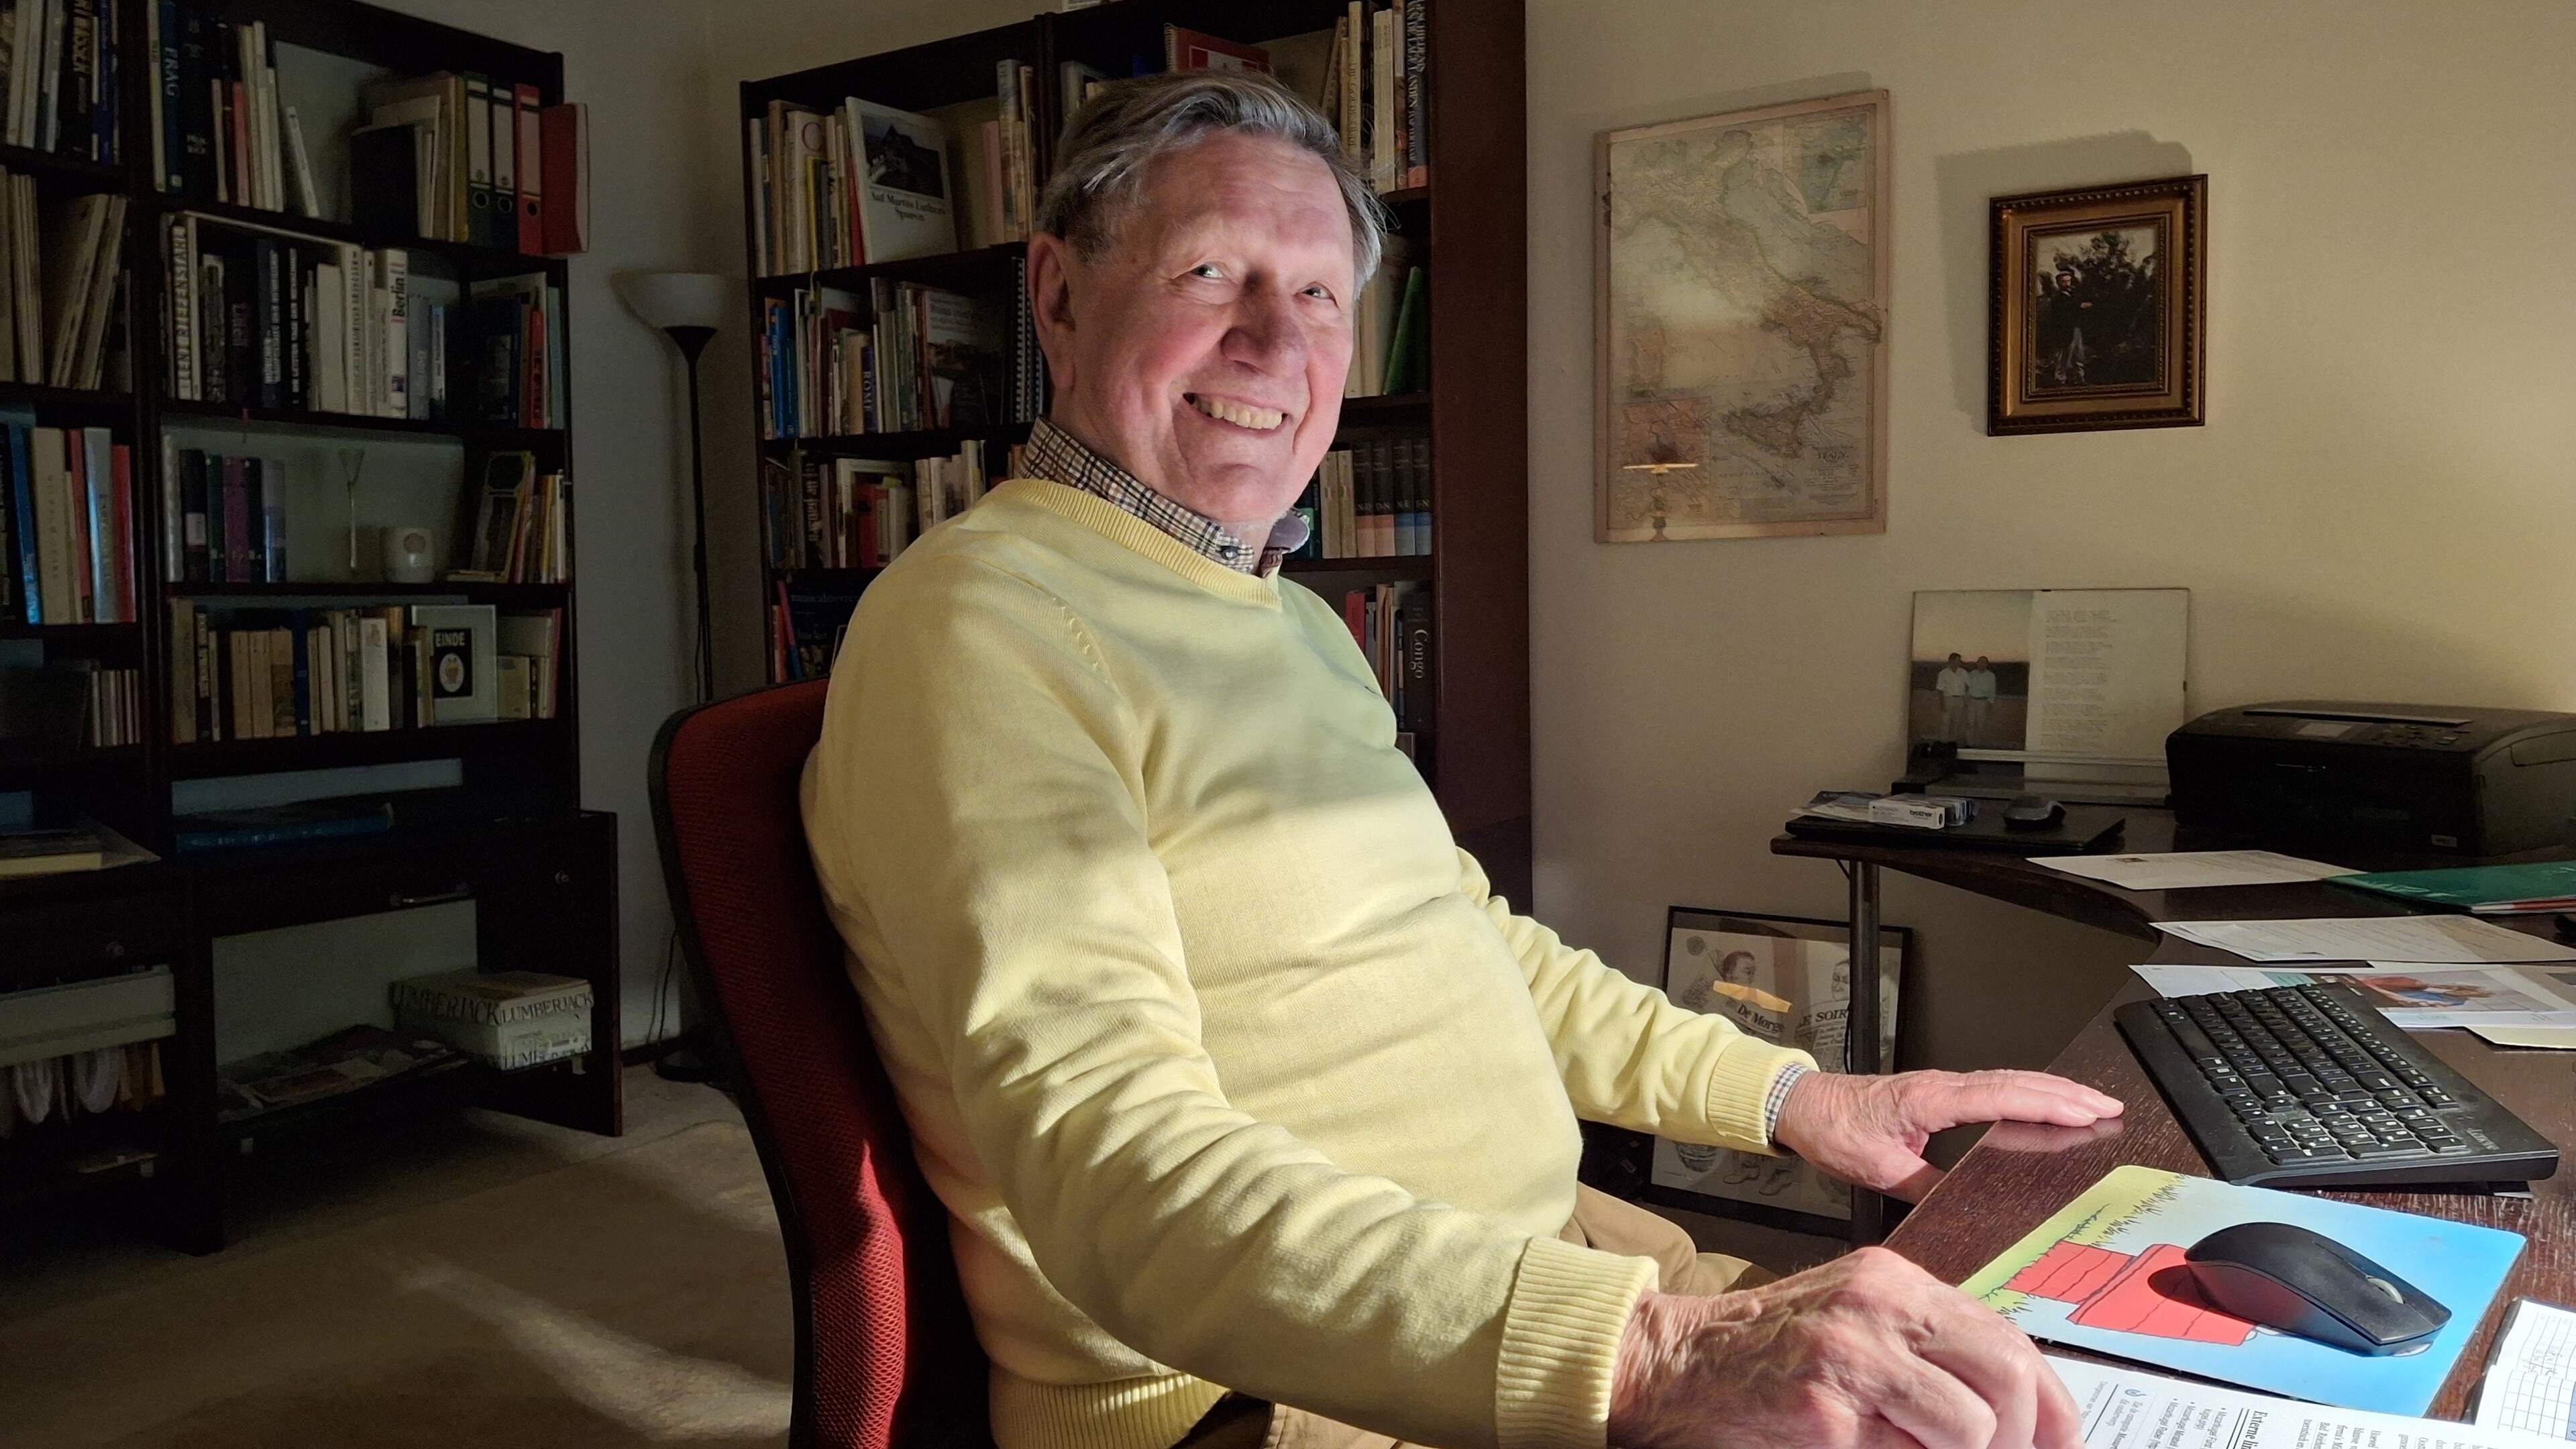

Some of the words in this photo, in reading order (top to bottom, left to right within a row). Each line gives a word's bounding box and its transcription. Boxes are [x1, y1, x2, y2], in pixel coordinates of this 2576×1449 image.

[435, 631, 466, 647] EINDE
[1409, 629, 1429, 679] Congo
[1909, 810, 1932, 818] brother
[501, 992, 594, 1024] LUMBERJACK
[1737, 1004, 1750, 1019] De
[1815, 1009, 1848, 1023] SOIR
[2245, 1410, 2268, 1440] Externe
